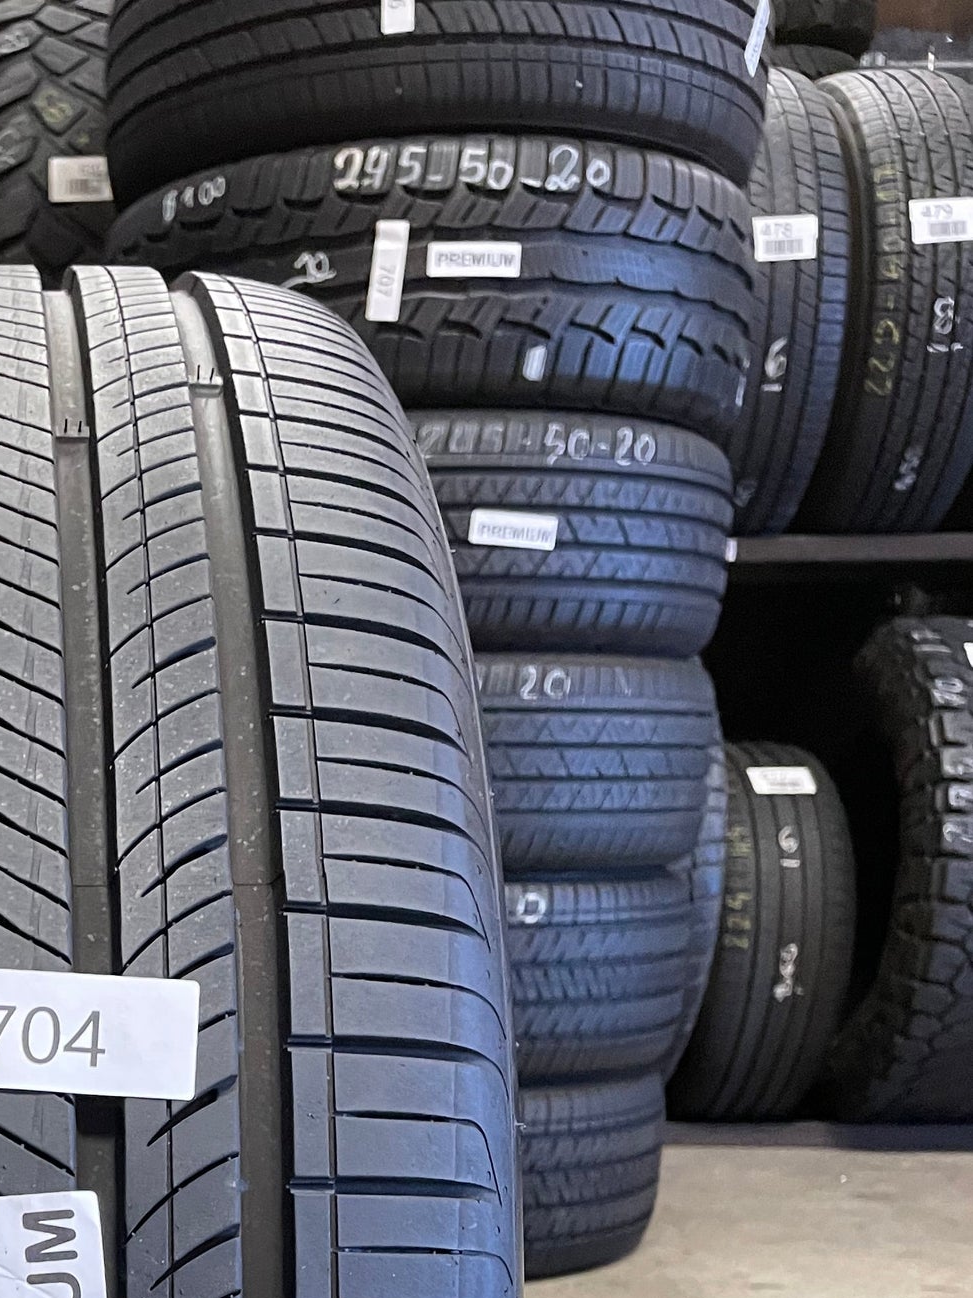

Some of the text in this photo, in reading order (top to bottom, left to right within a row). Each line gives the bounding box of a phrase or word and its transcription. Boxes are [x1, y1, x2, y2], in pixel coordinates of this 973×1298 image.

[437, 252, 516, 267] PREMIUM
[376, 265, 396, 297] 707
[764, 337, 787, 378] 6
[479, 523, 552, 544] PREMIUM
